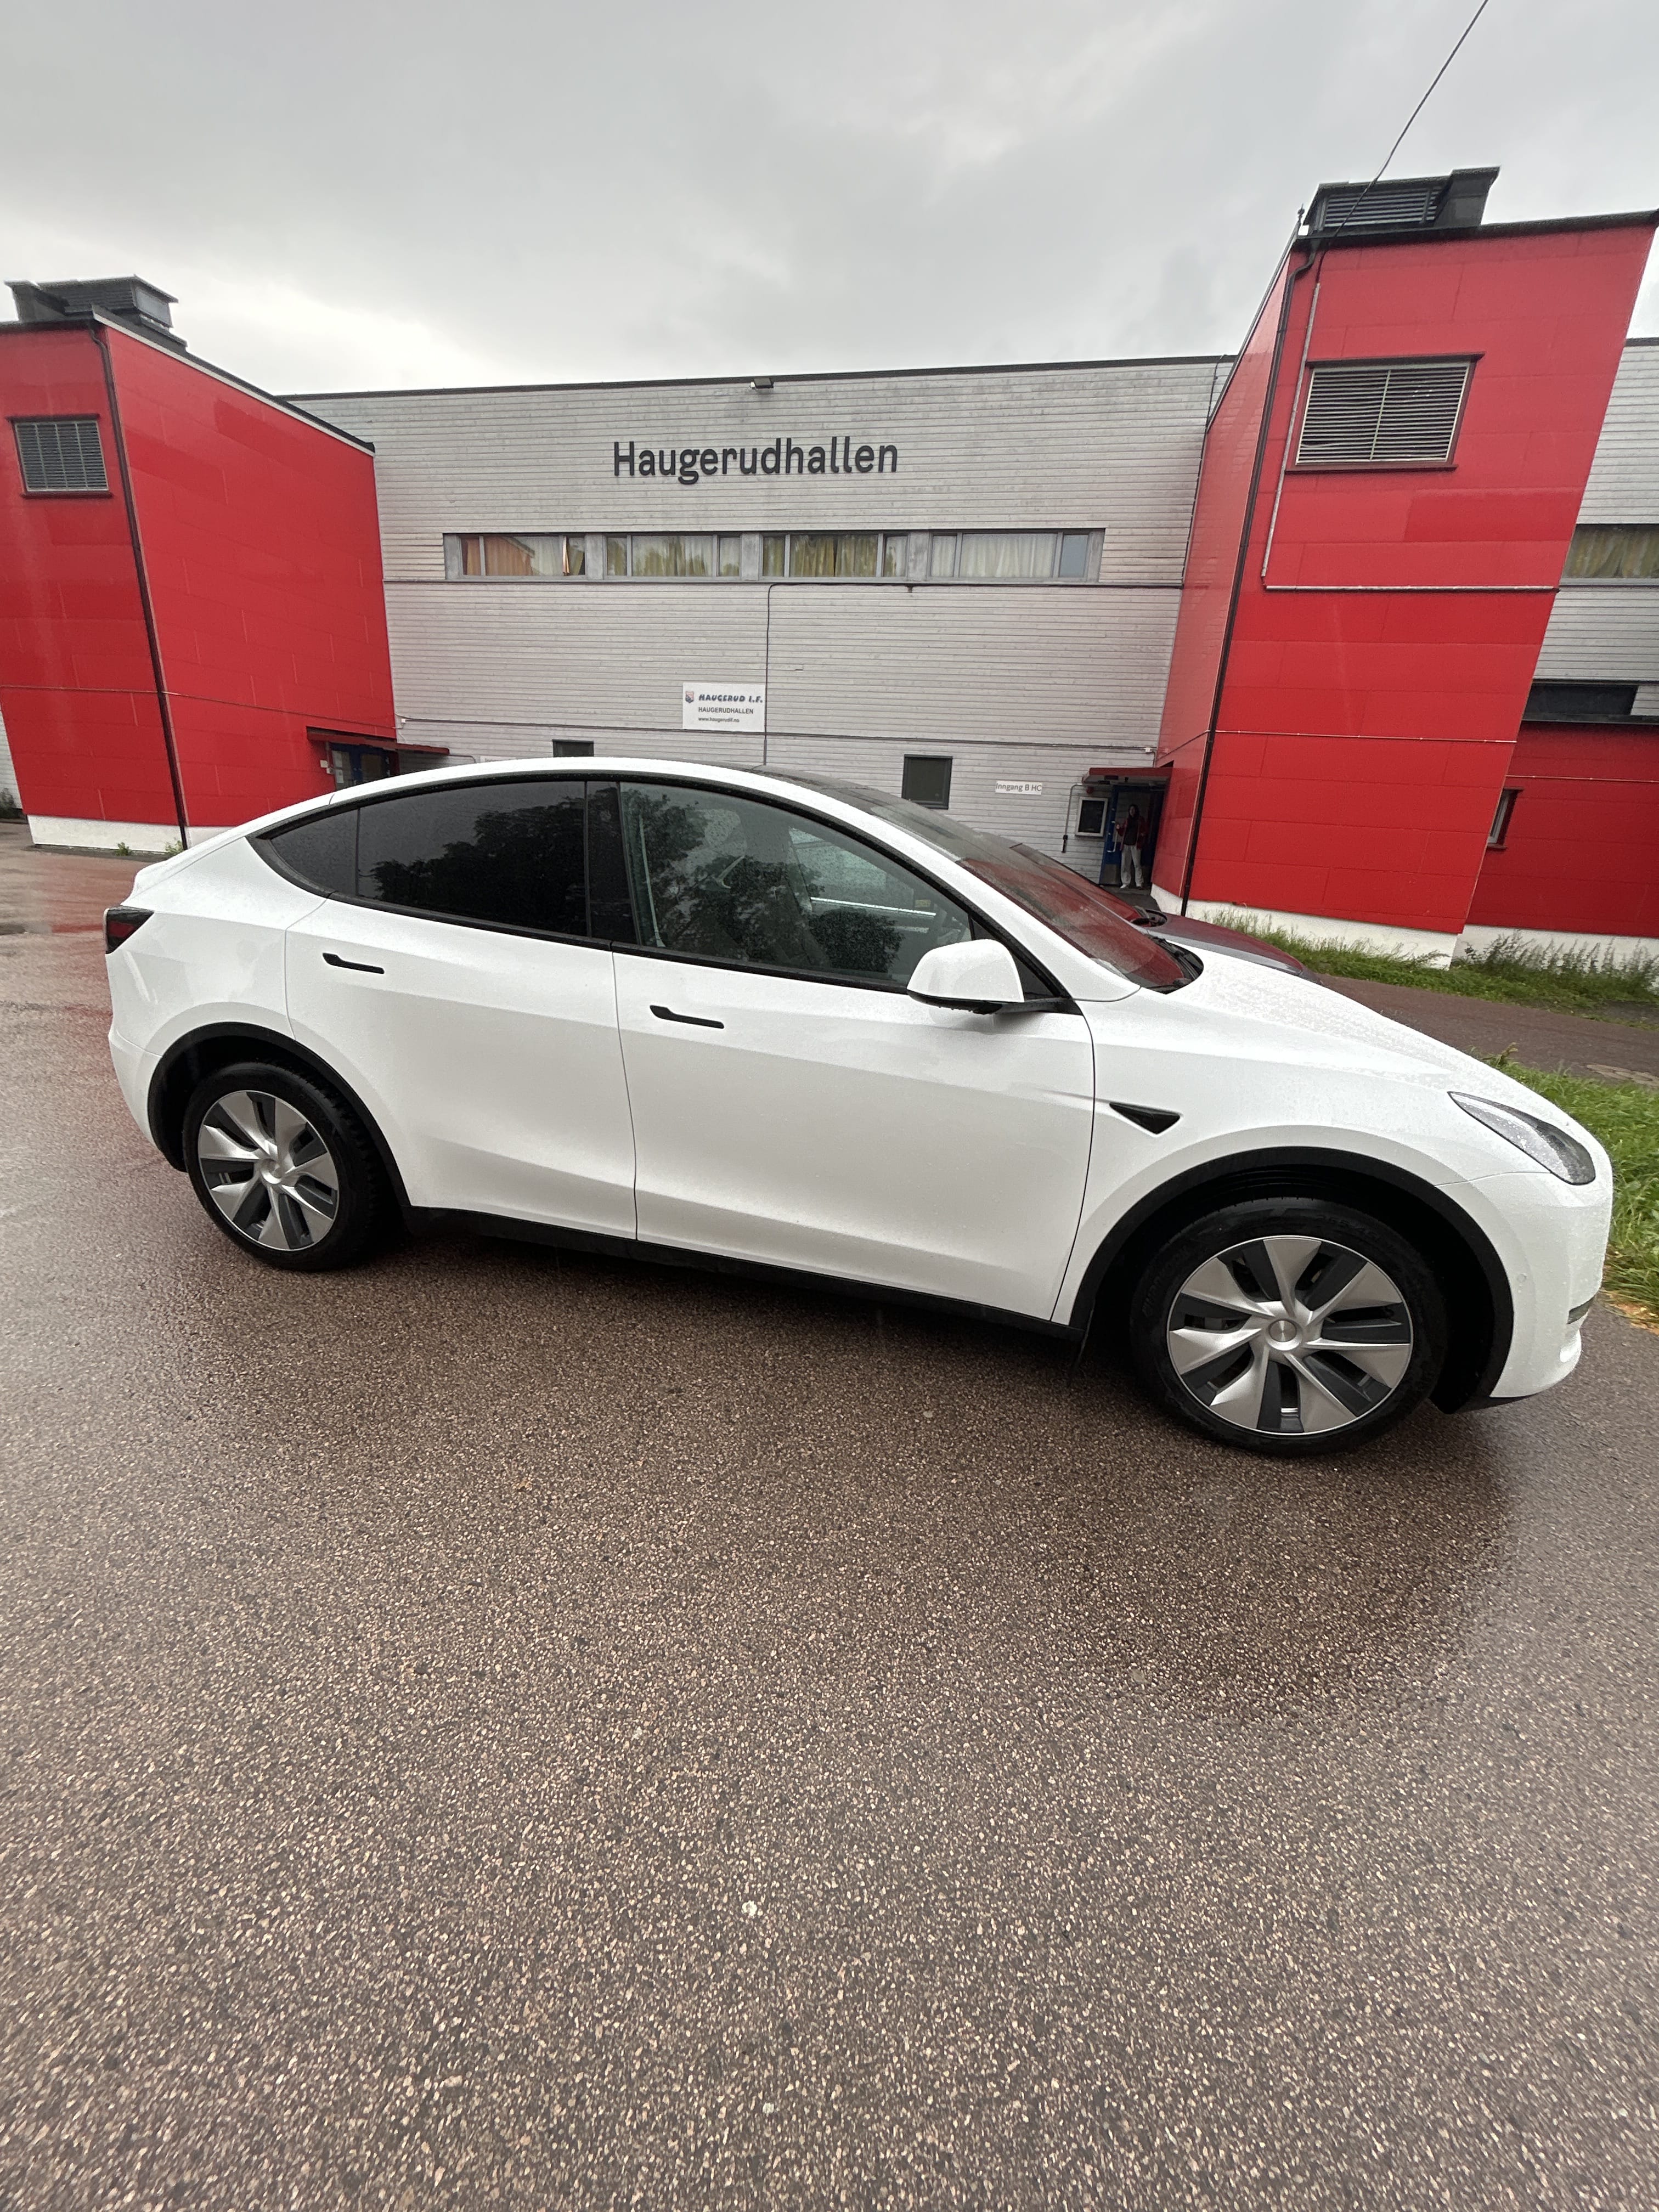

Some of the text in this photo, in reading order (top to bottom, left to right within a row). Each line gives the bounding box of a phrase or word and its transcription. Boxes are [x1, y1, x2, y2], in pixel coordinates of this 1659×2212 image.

[614, 436, 898, 485] Haugerudhallen
[698, 694, 745, 702] HAUGERUD
[996, 783, 1023, 792] Inngang
